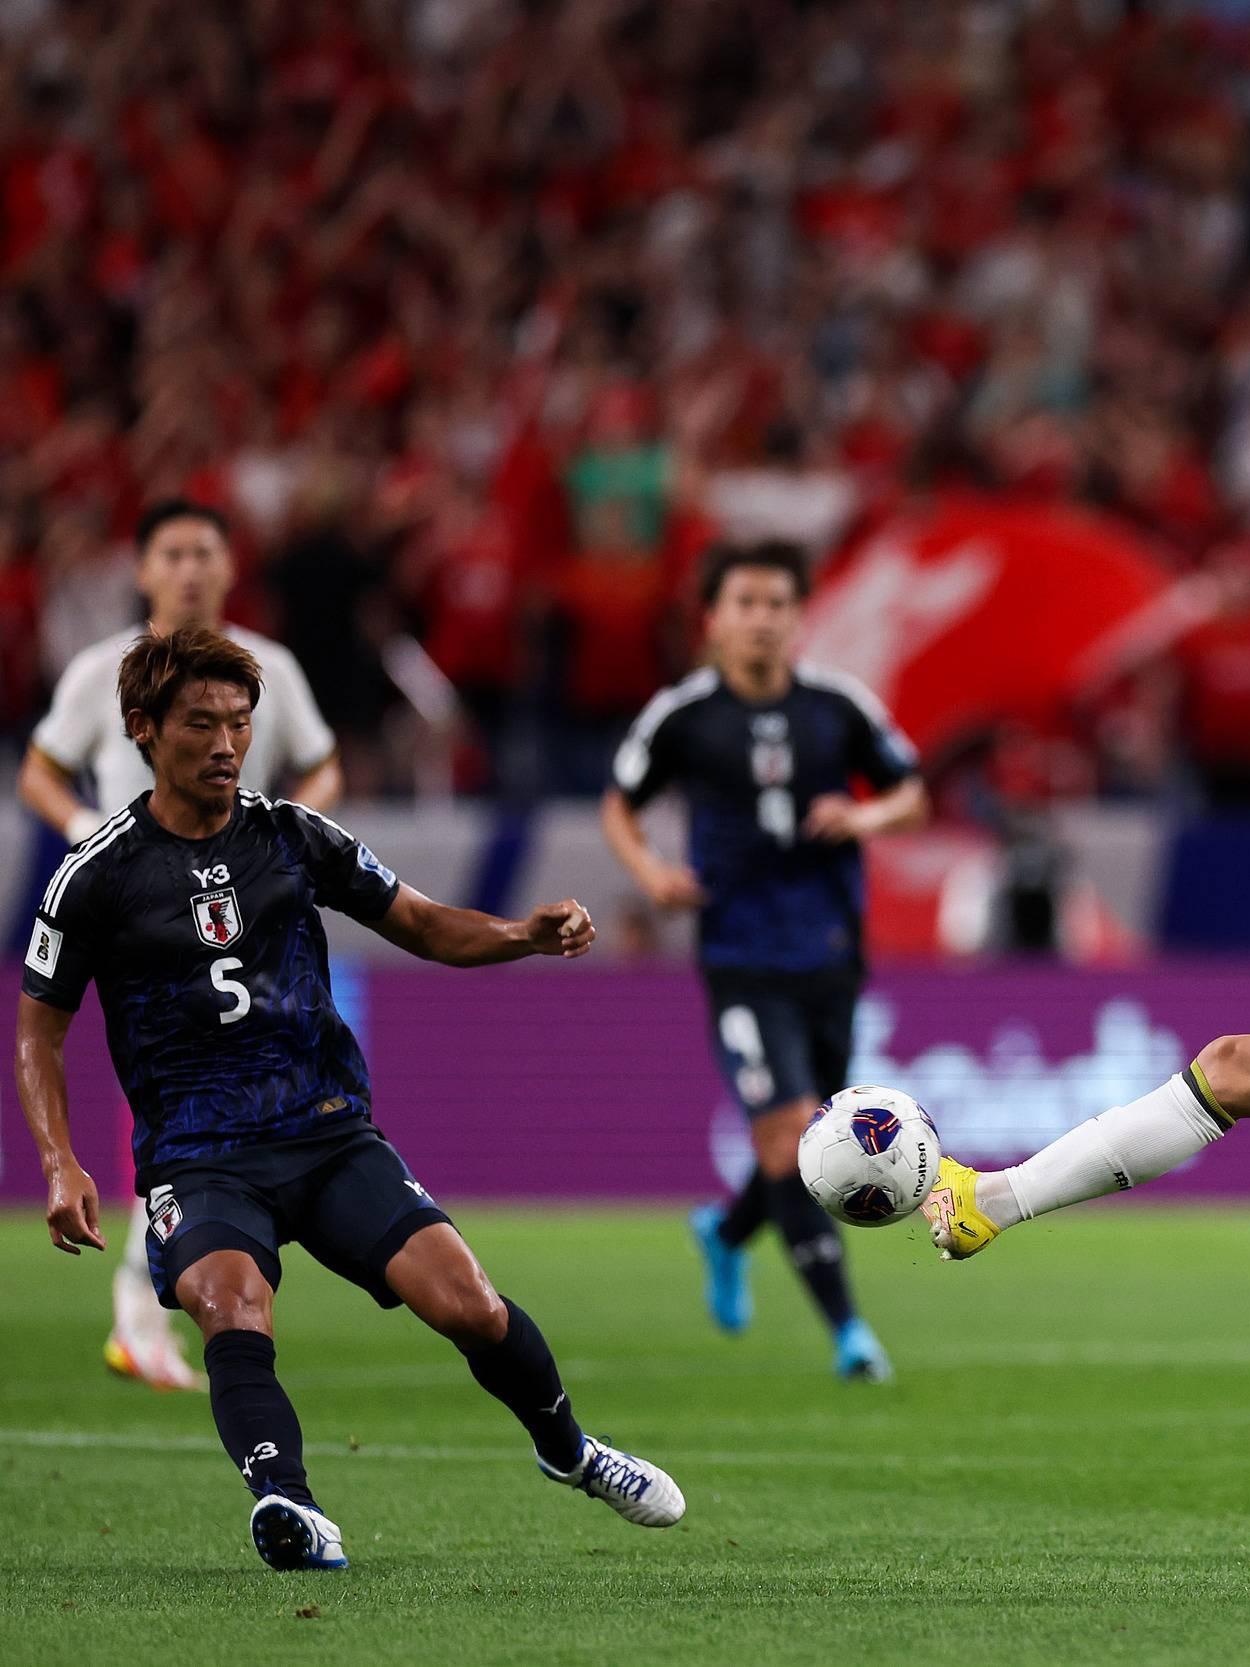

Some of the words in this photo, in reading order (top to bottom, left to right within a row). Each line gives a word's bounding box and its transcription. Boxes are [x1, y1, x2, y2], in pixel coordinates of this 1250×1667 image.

[192, 864, 230, 888] Y-3
[202, 893, 224, 902] JAPAN
[210, 957, 251, 1024] 5
[913, 1142, 927, 1198] molten
